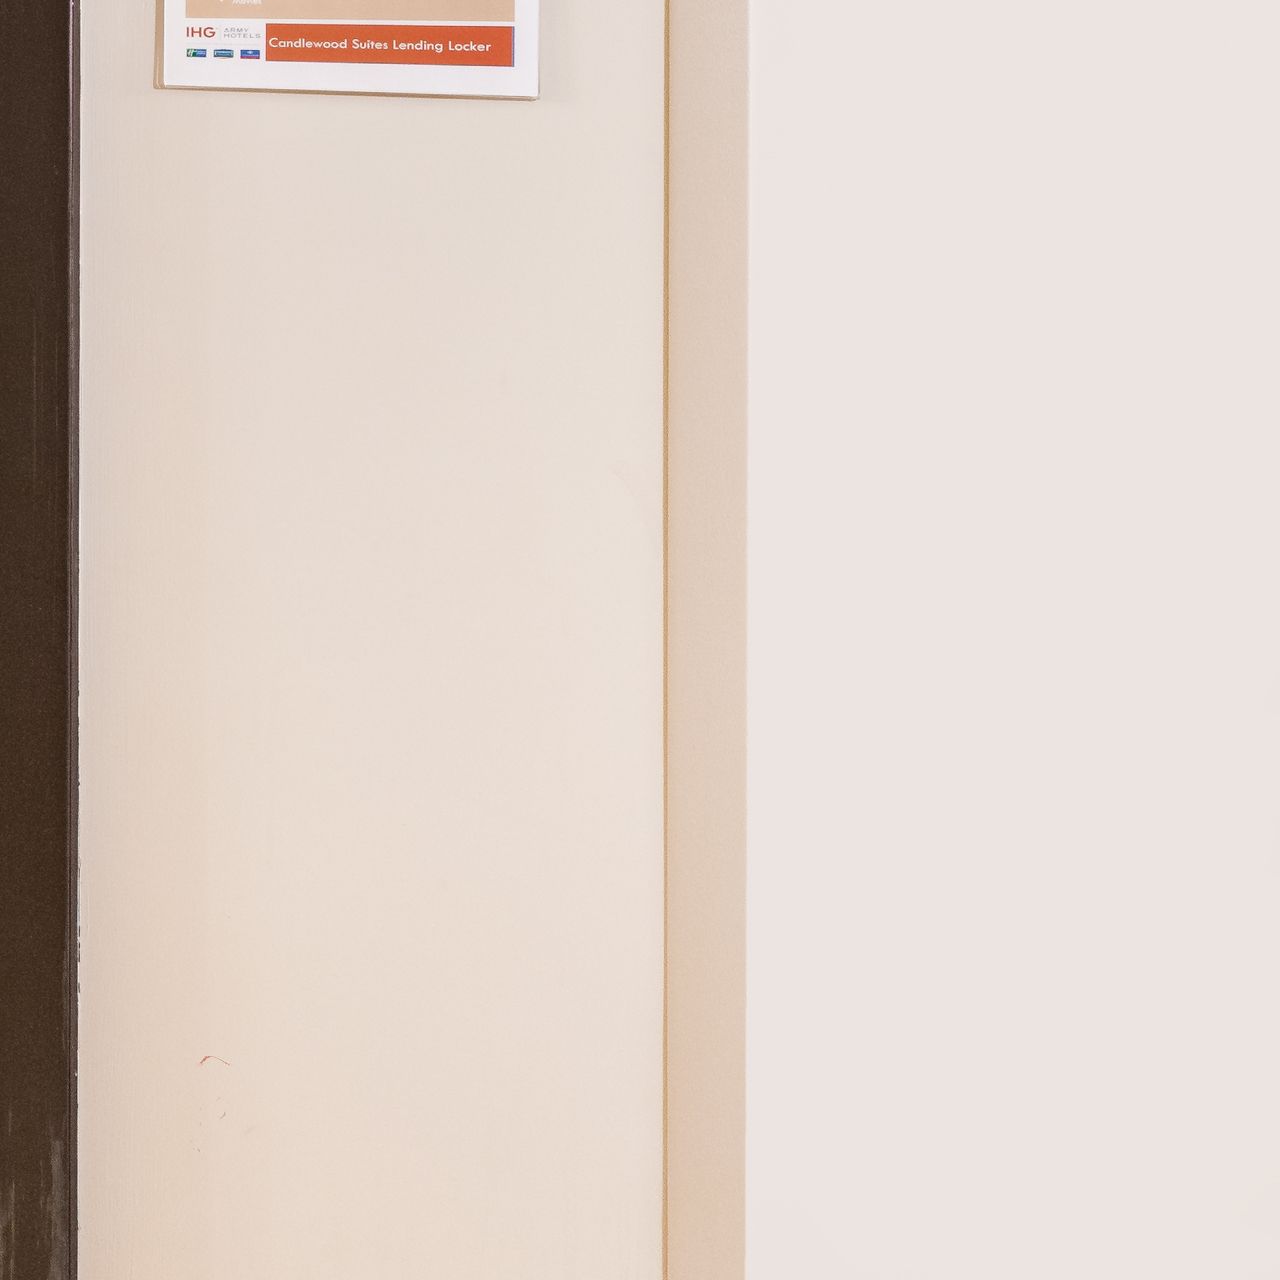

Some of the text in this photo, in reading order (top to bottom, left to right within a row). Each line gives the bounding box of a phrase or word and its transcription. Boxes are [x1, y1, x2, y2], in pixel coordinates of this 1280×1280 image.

[186, 26, 216, 38] IHG
[269, 37, 492, 54] Candlewood Suites Lending Locker
